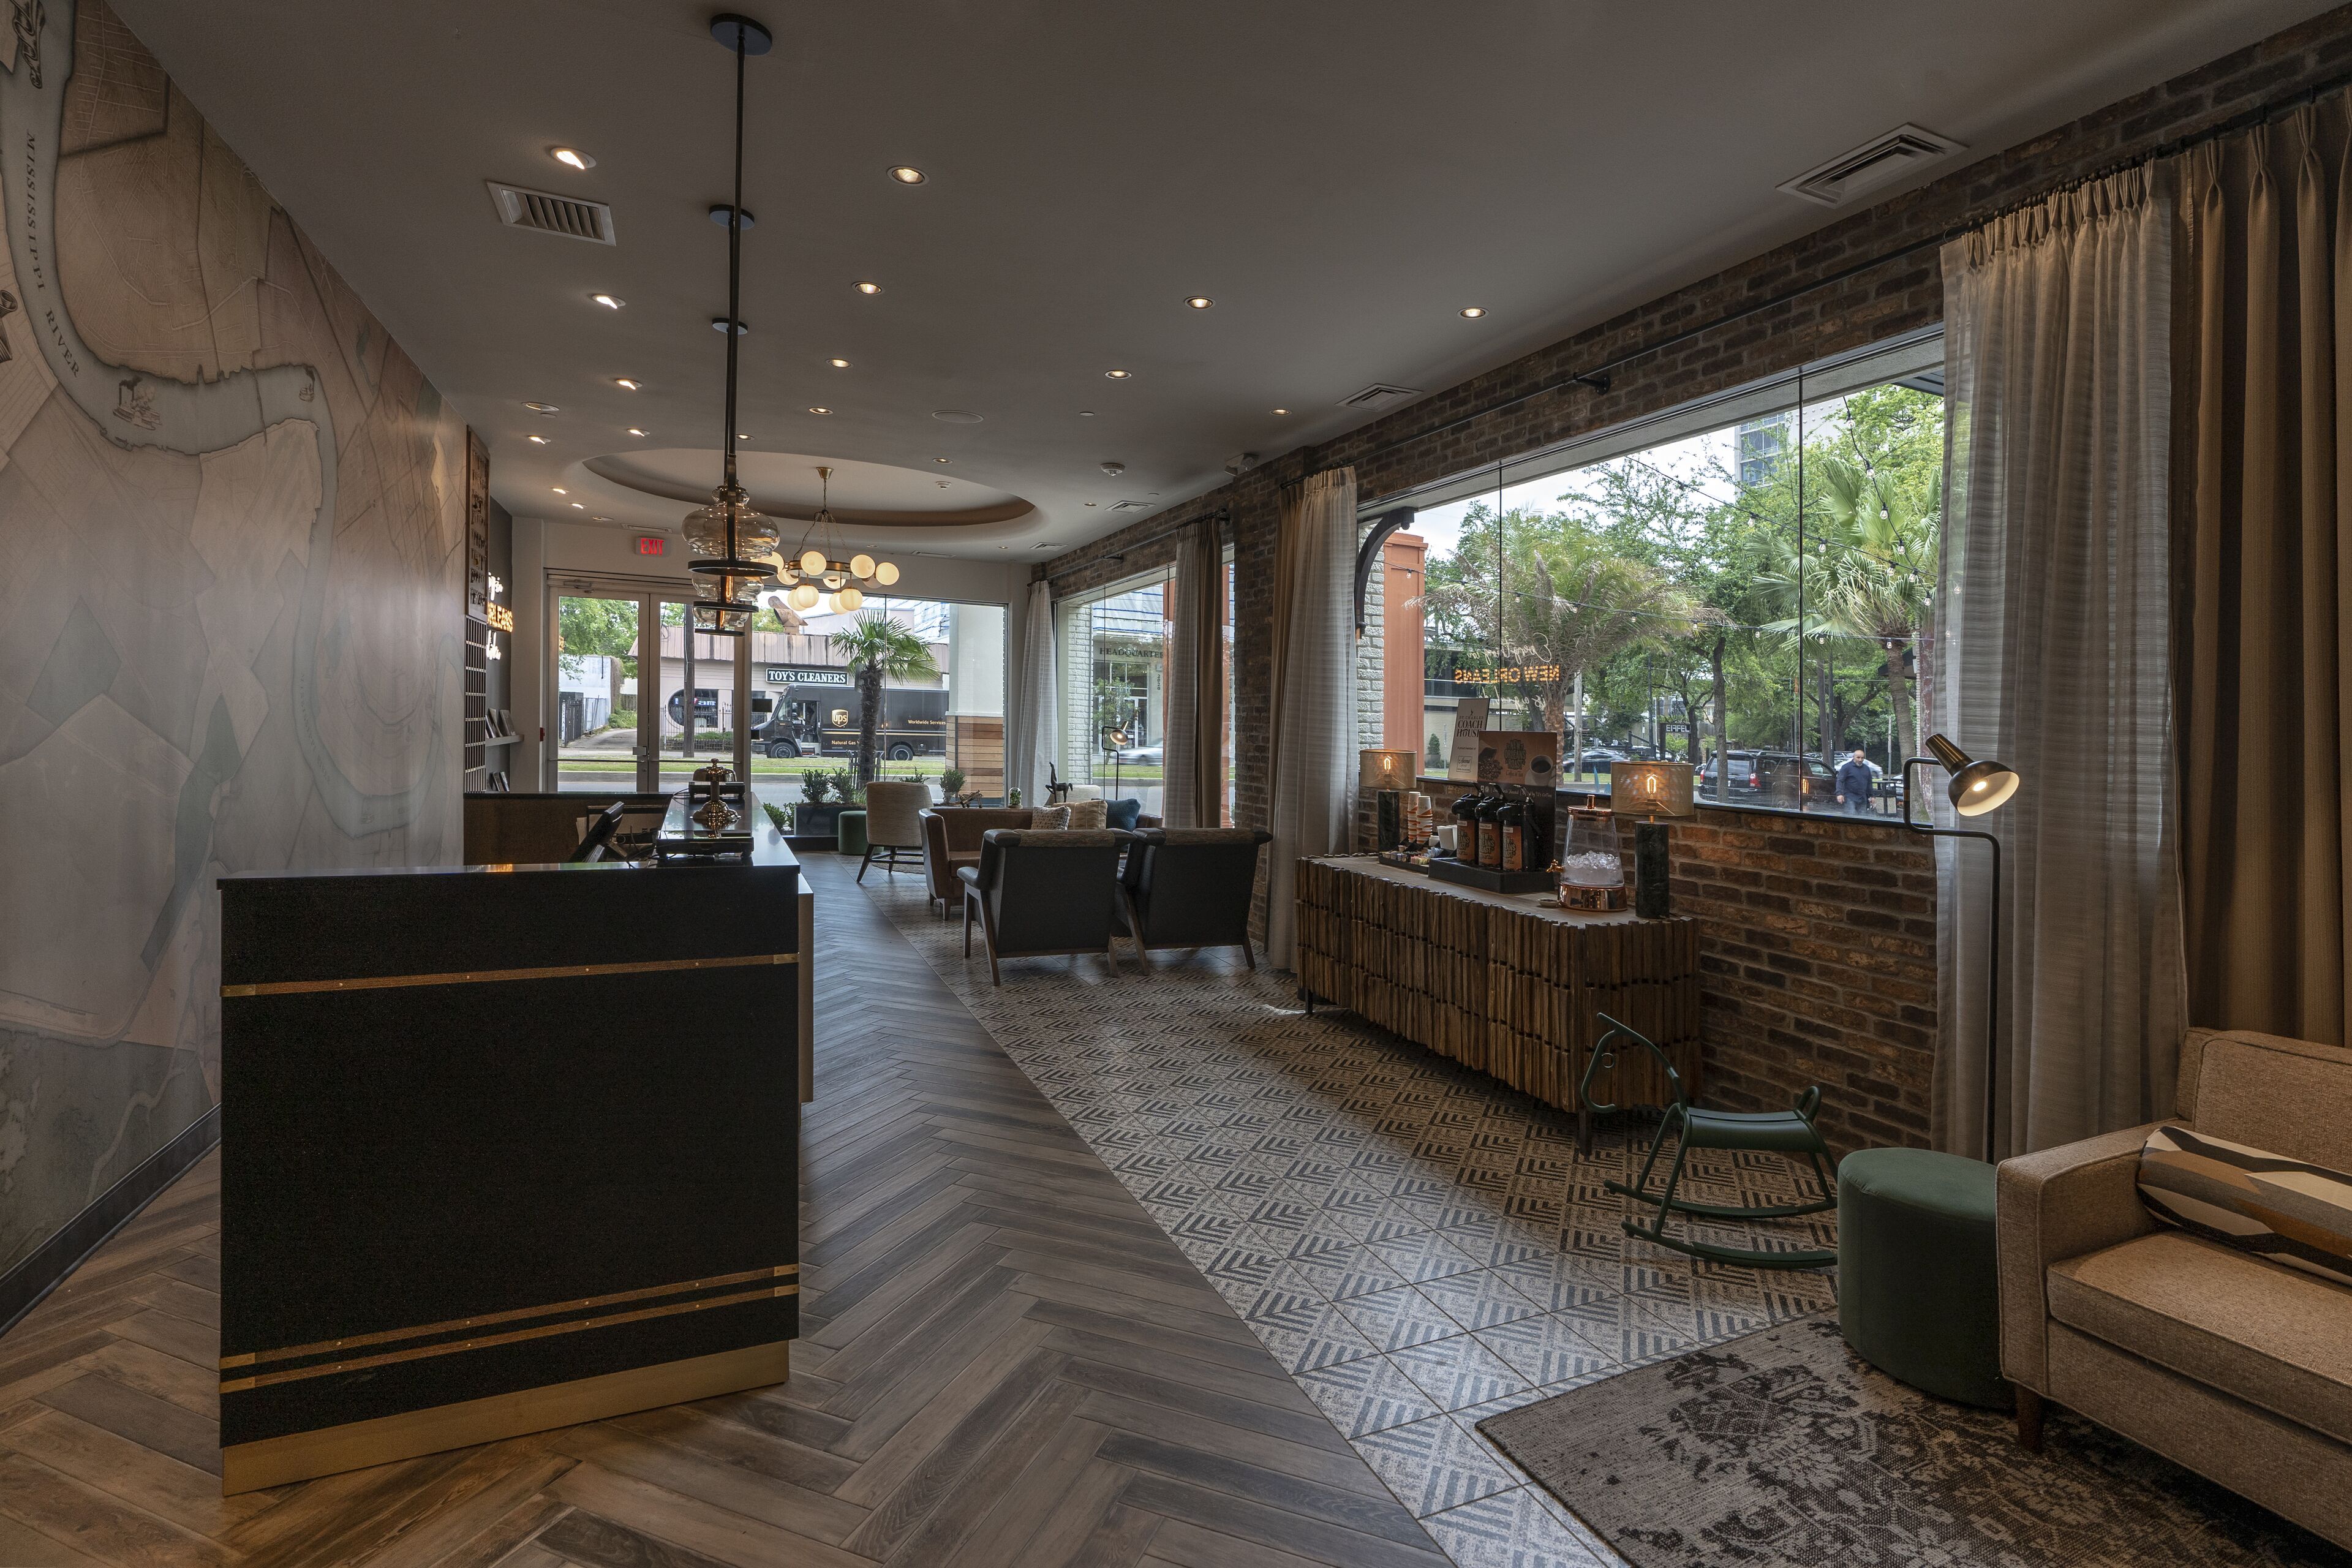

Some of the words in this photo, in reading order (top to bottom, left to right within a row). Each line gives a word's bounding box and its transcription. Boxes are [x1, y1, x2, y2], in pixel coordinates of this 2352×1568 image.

[25, 132, 46, 292] MISSISSIPPI
[45, 307, 80, 378] RIVER
[641, 538, 664, 556] EXIT
[488, 601, 513, 633] RLEANS
[769, 670, 796, 681] TOY'S
[797, 672, 846, 684] CLEANERS
[833, 714, 847, 725] ups
[1458, 720, 1483, 728] COACH
[1510, 739, 1521, 750] NEW
[1504, 749, 1526, 760] ORLEANS
[1507, 759, 1523, 770] ROAST
